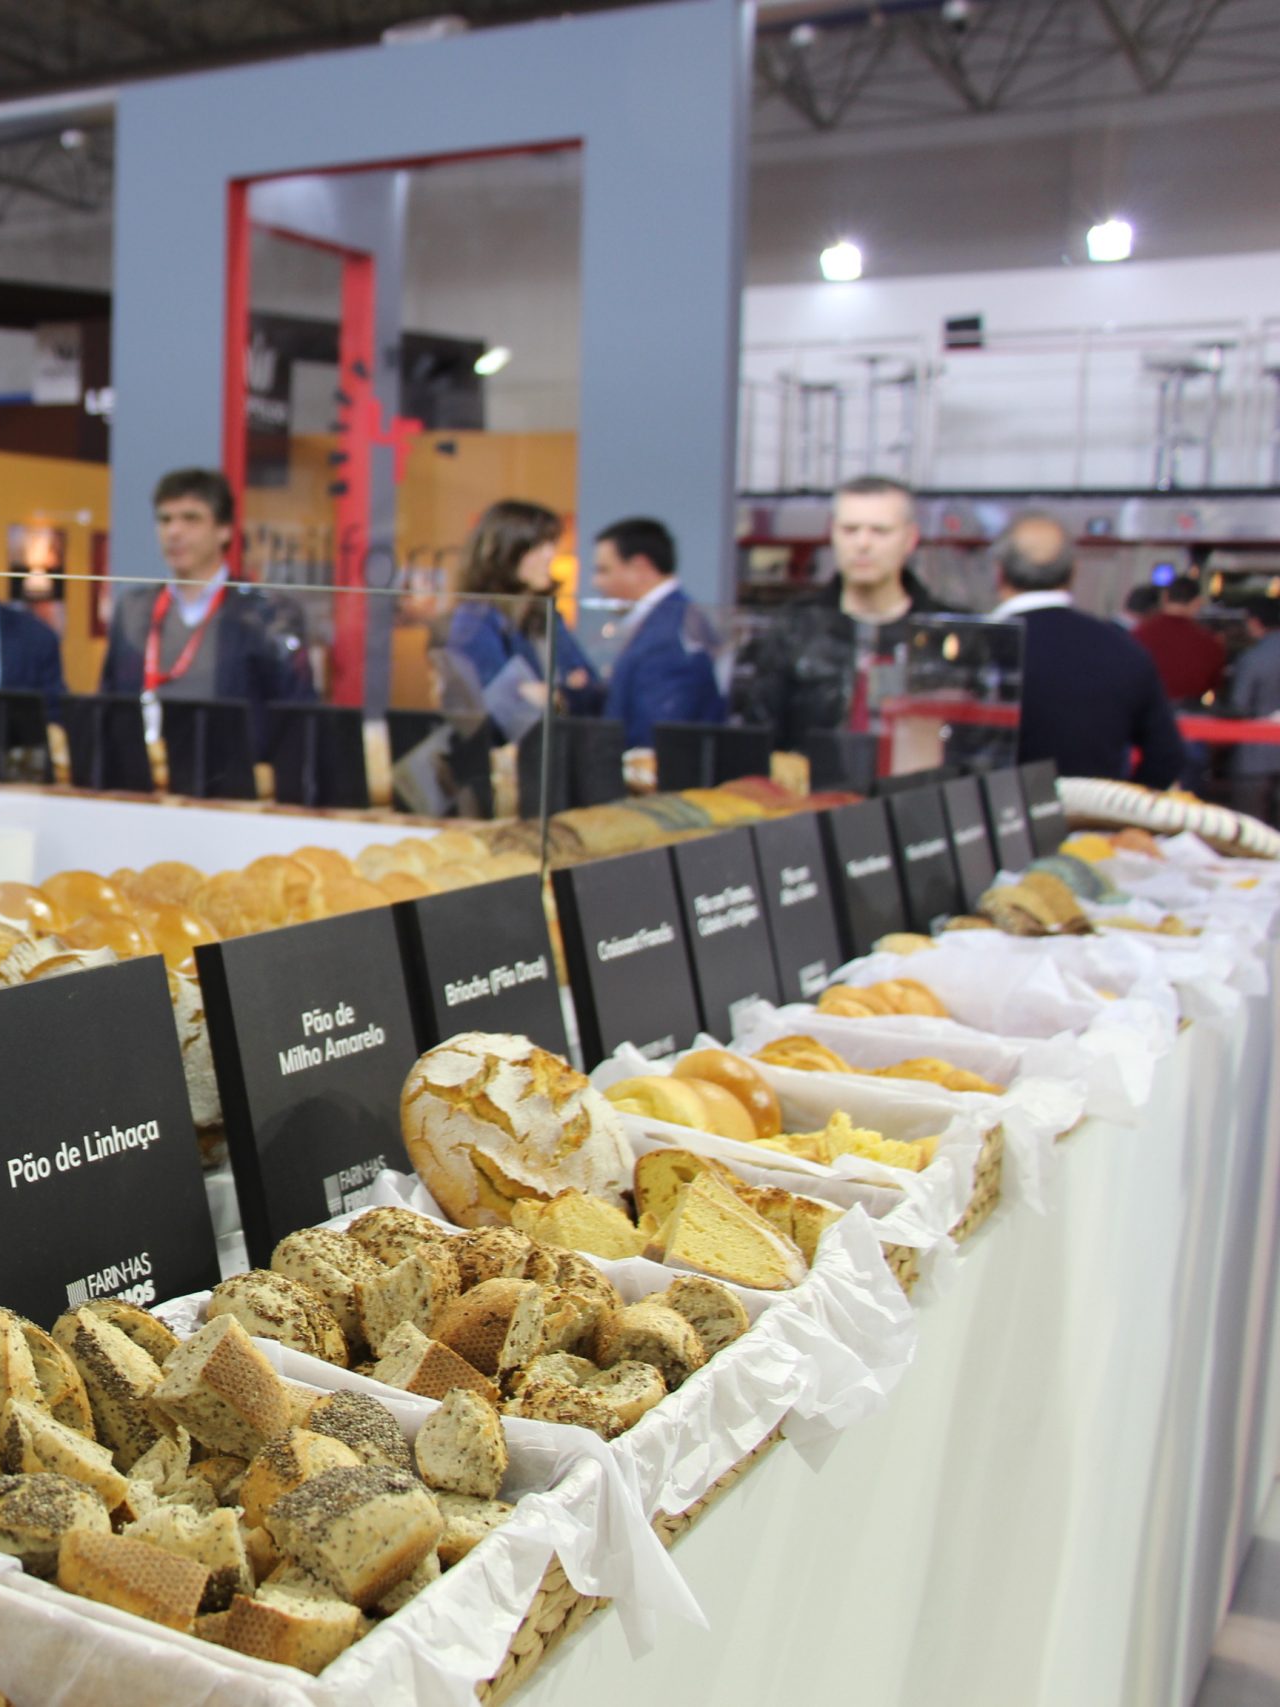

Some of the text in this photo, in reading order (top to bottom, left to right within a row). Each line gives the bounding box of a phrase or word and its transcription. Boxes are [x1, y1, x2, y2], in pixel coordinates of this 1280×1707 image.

[444, 973, 491, 1007] Brioche
[490, 965, 517, 996] (Pão
[301, 1001, 356, 1037] Pão de
[278, 1022, 386, 1076] Milho Amarelo
[7, 1119, 161, 1189] Pão de Linhaça
[86, 1252, 153, 1298] FARINHAS
